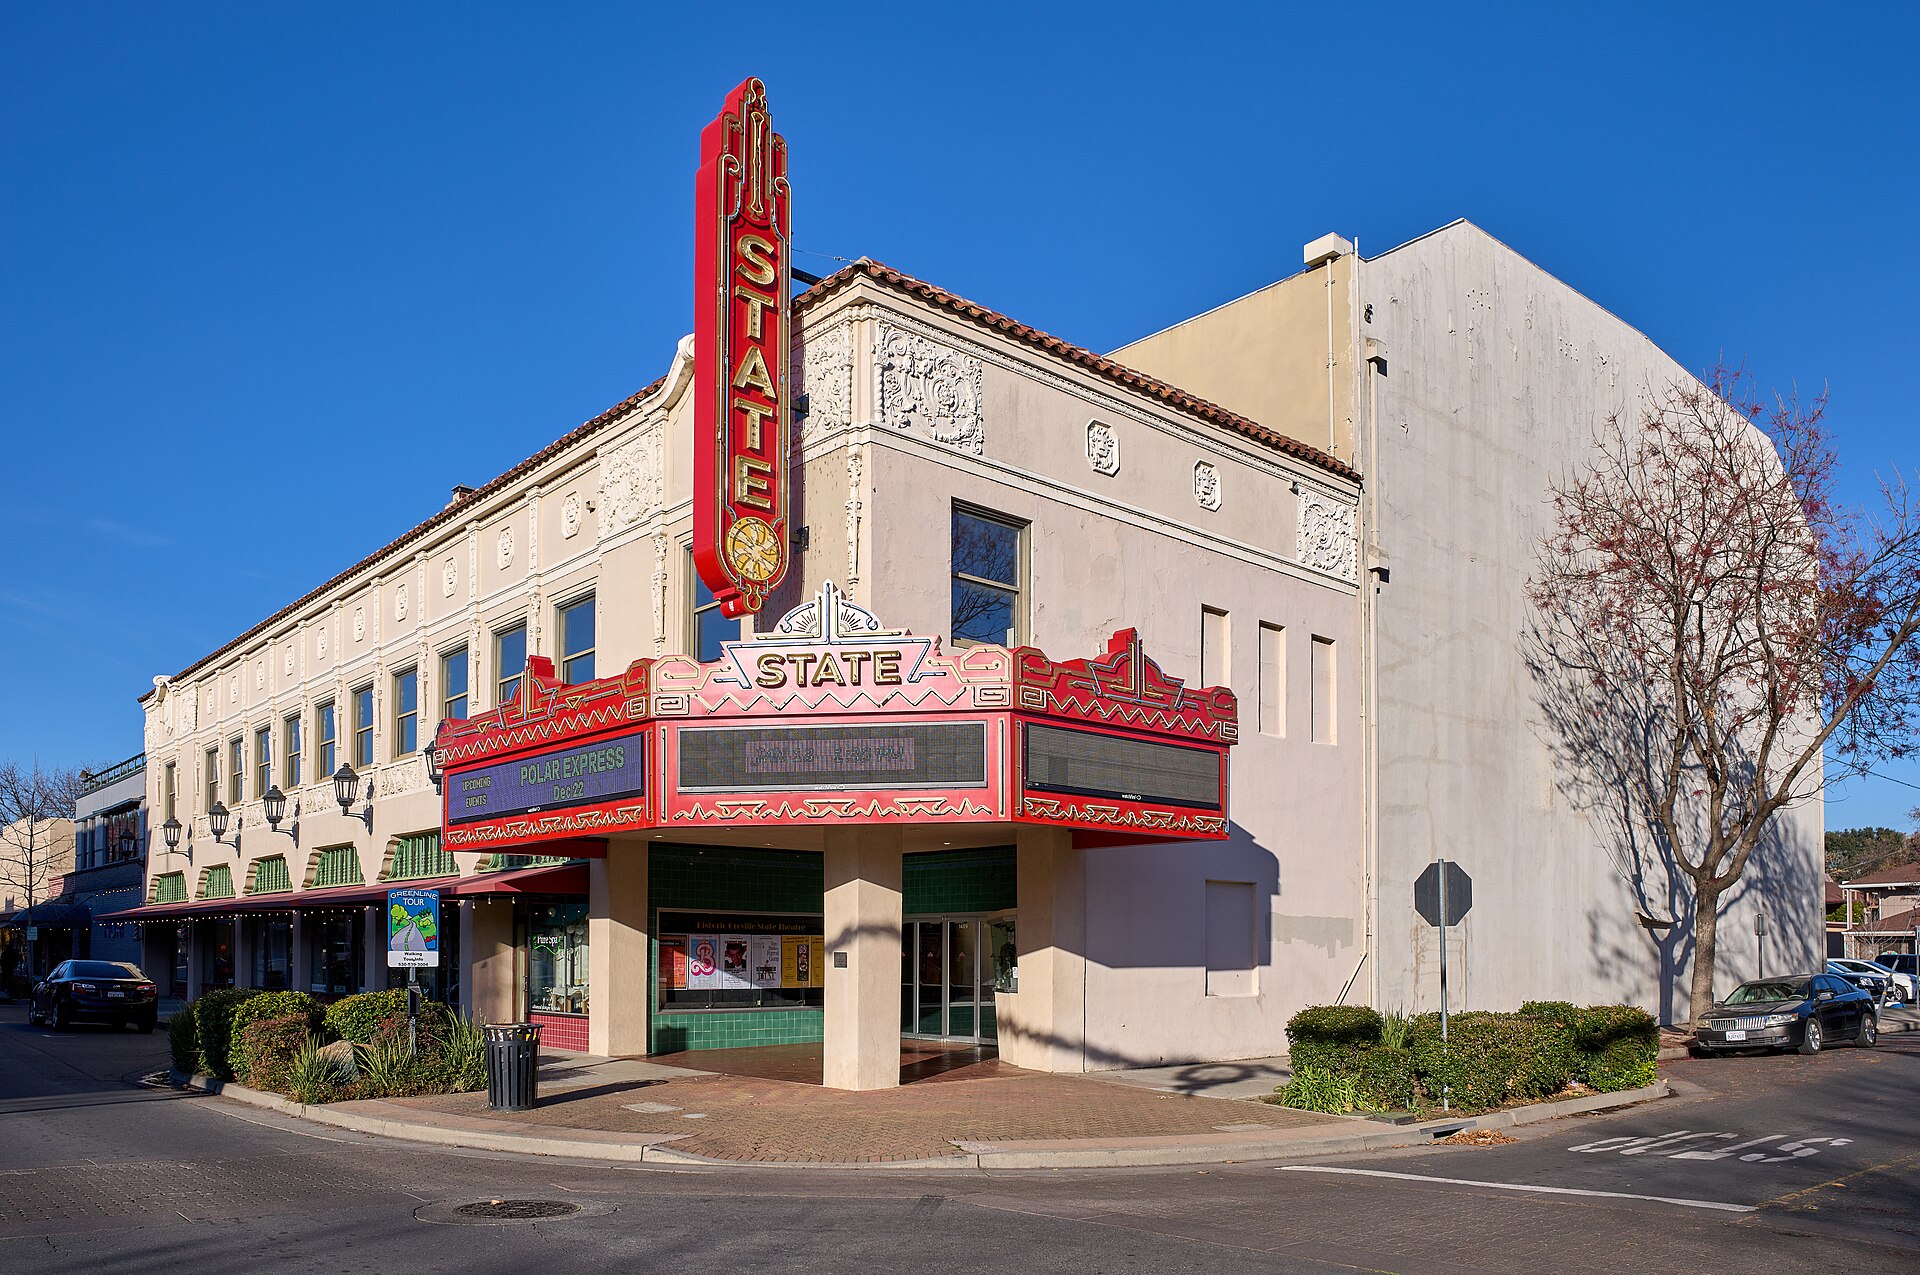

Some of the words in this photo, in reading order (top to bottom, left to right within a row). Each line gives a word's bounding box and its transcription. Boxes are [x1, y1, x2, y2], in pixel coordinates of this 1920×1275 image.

[732, 233, 777, 511] STATE
[755, 650, 903, 689] STATE
[520, 759, 561, 787] POLAR
[563, 746, 625, 779] EXPRESS
[462, 776, 491, 792] UPCOMING
[554, 785, 571, 801] Dec
[572, 782, 584, 798] 22
[465, 795, 487, 808] EVENTS
[390, 890, 438, 900] GREENLINE
[403, 898, 425, 906] TOUR
[696, 921, 726, 929] Historic
[757, 922, 777, 930] State
